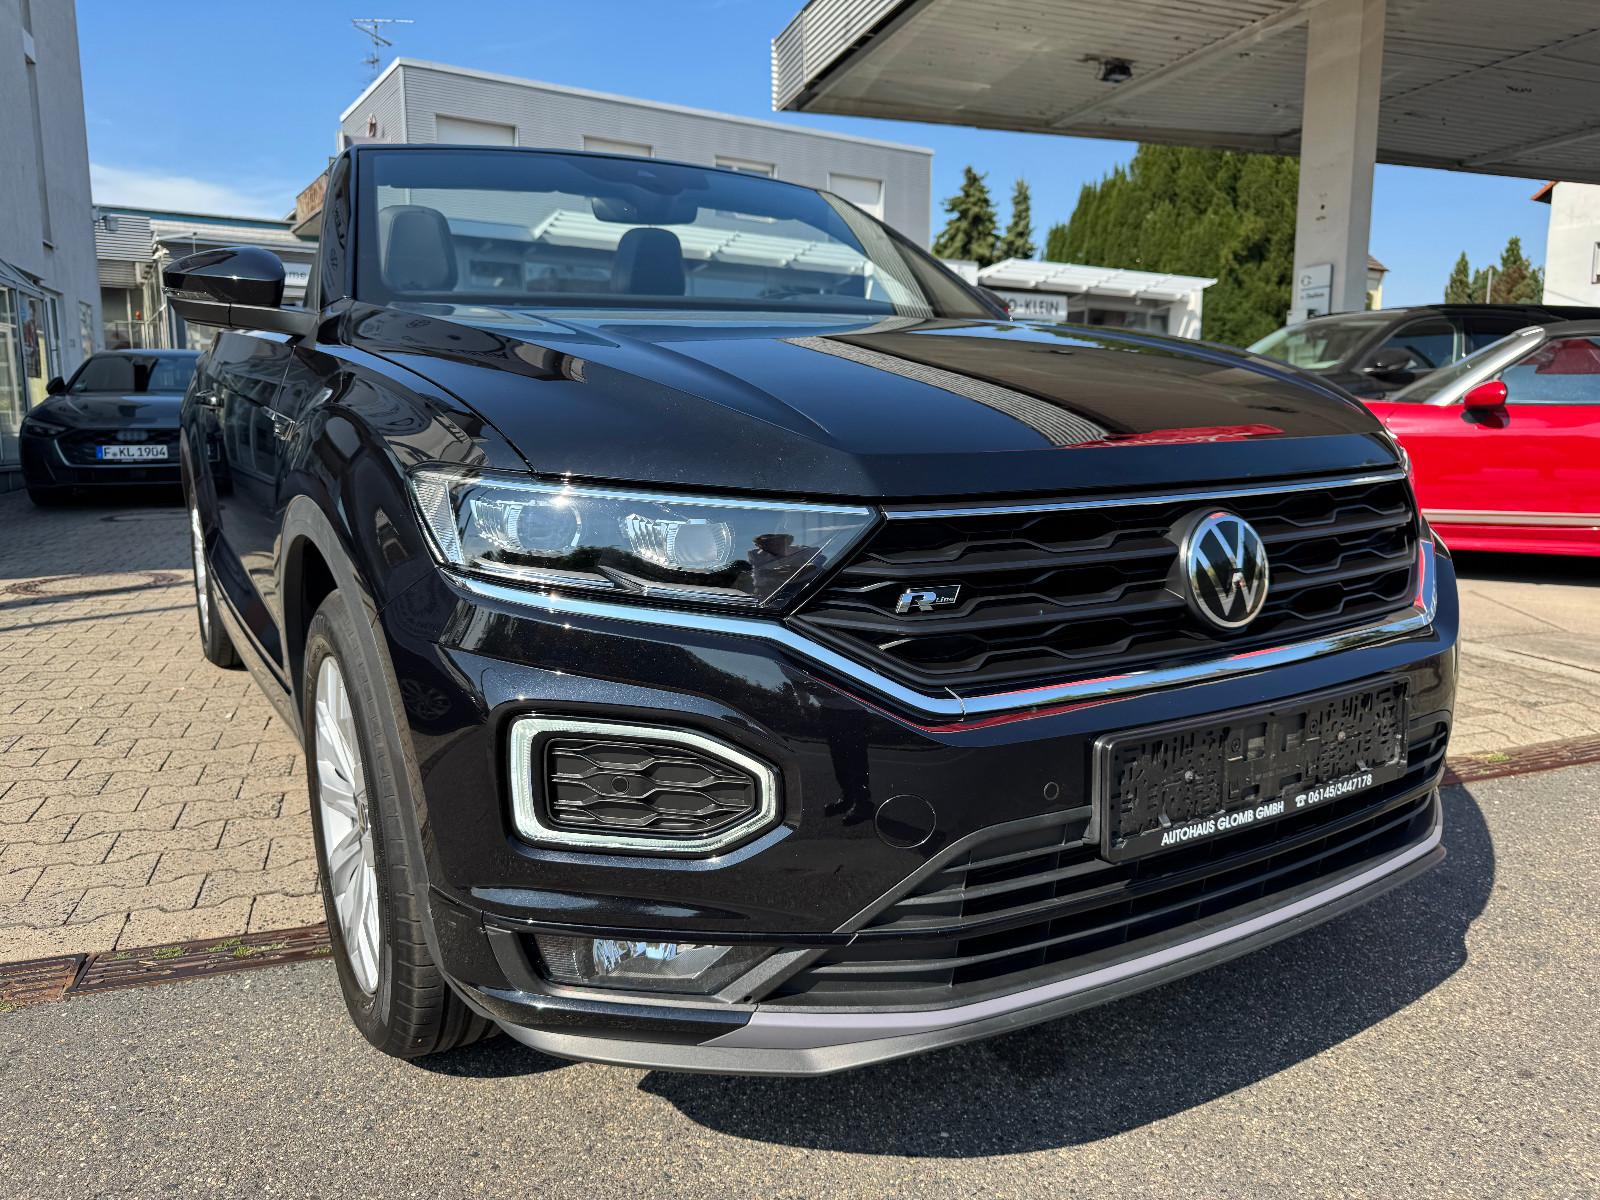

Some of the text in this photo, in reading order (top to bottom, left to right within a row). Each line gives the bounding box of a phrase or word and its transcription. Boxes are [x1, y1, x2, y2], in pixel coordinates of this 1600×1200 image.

[1004, 298, 1059, 315] O-KLEIN
[103, 447, 166, 457] F KL 1904
[1161, 774, 1373, 846] AUTOHAUS GLOMB GMBH 06145/3447178
